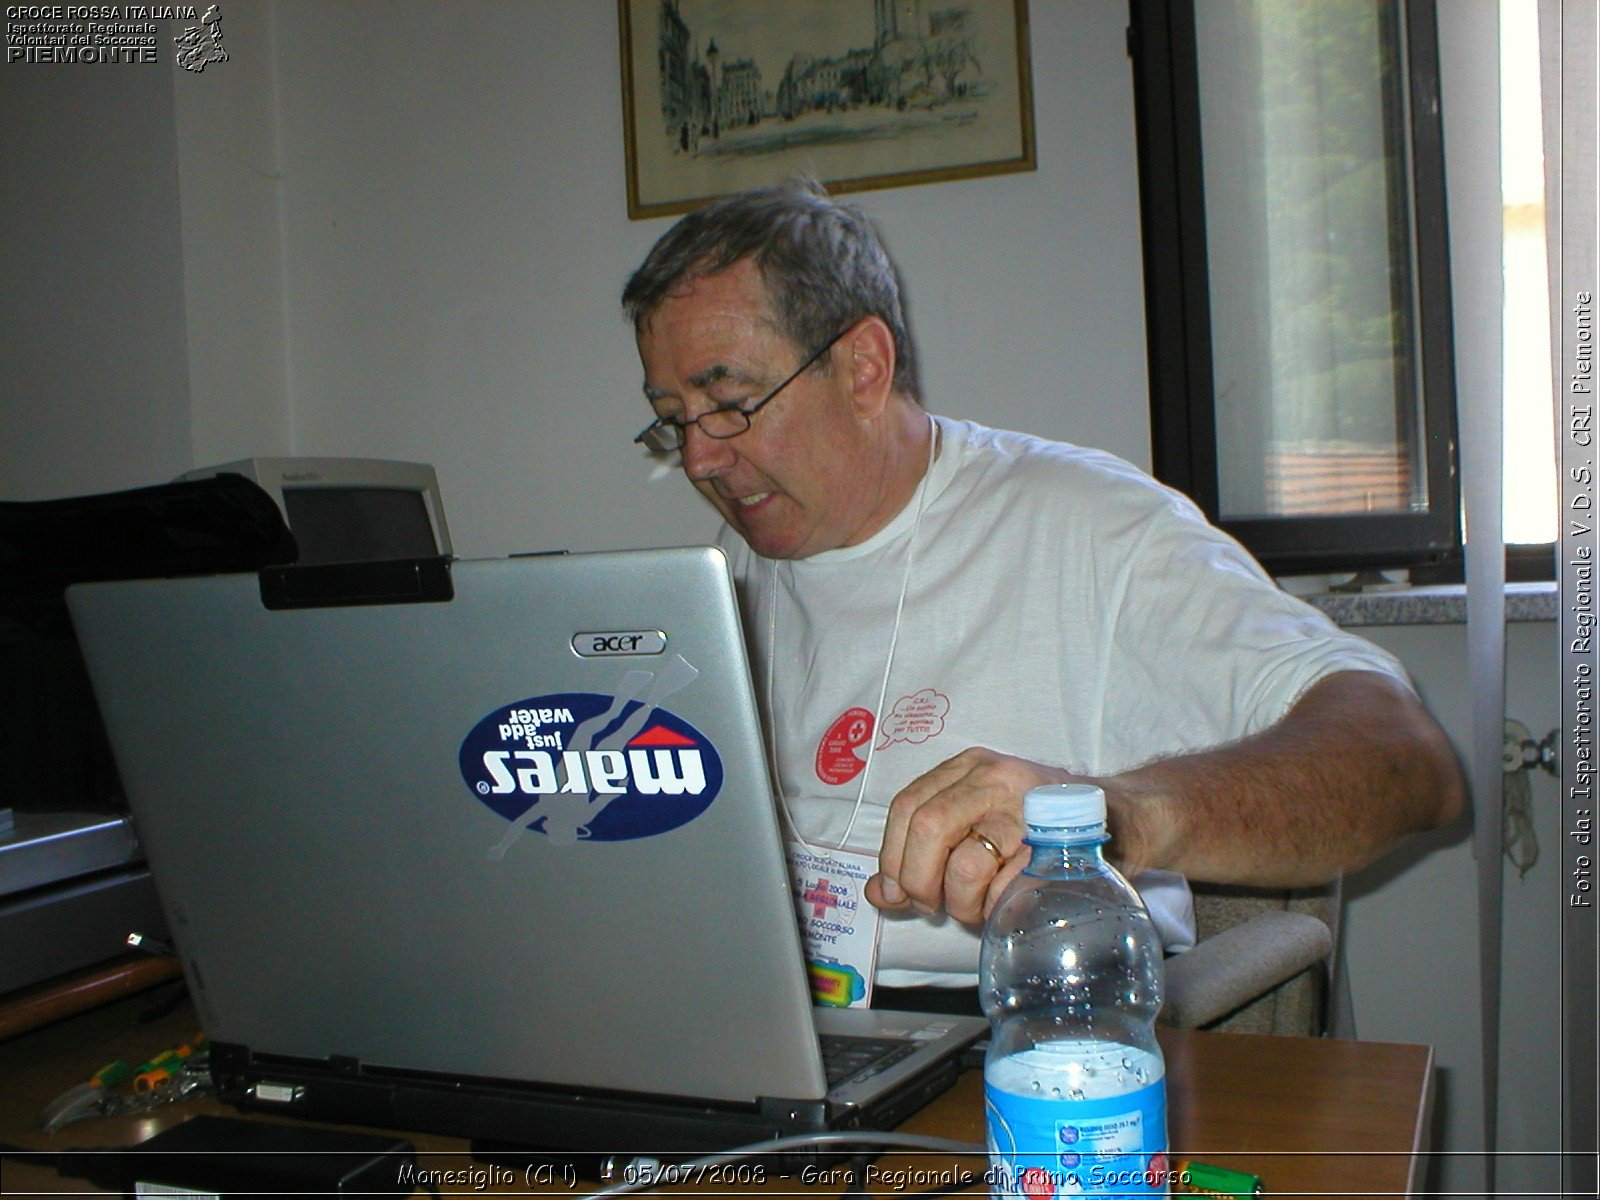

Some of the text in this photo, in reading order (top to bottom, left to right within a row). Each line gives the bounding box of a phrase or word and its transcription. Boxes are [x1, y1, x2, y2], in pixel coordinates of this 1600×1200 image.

[592, 634, 643, 652] acer
[508, 707, 575, 727] water
[498, 723, 537, 741] add
[526, 731, 563, 750] just
[482, 749, 707, 796] mares
[829, 884, 848, 896] 2008
[810, 918, 854, 936] SOCCORSO
